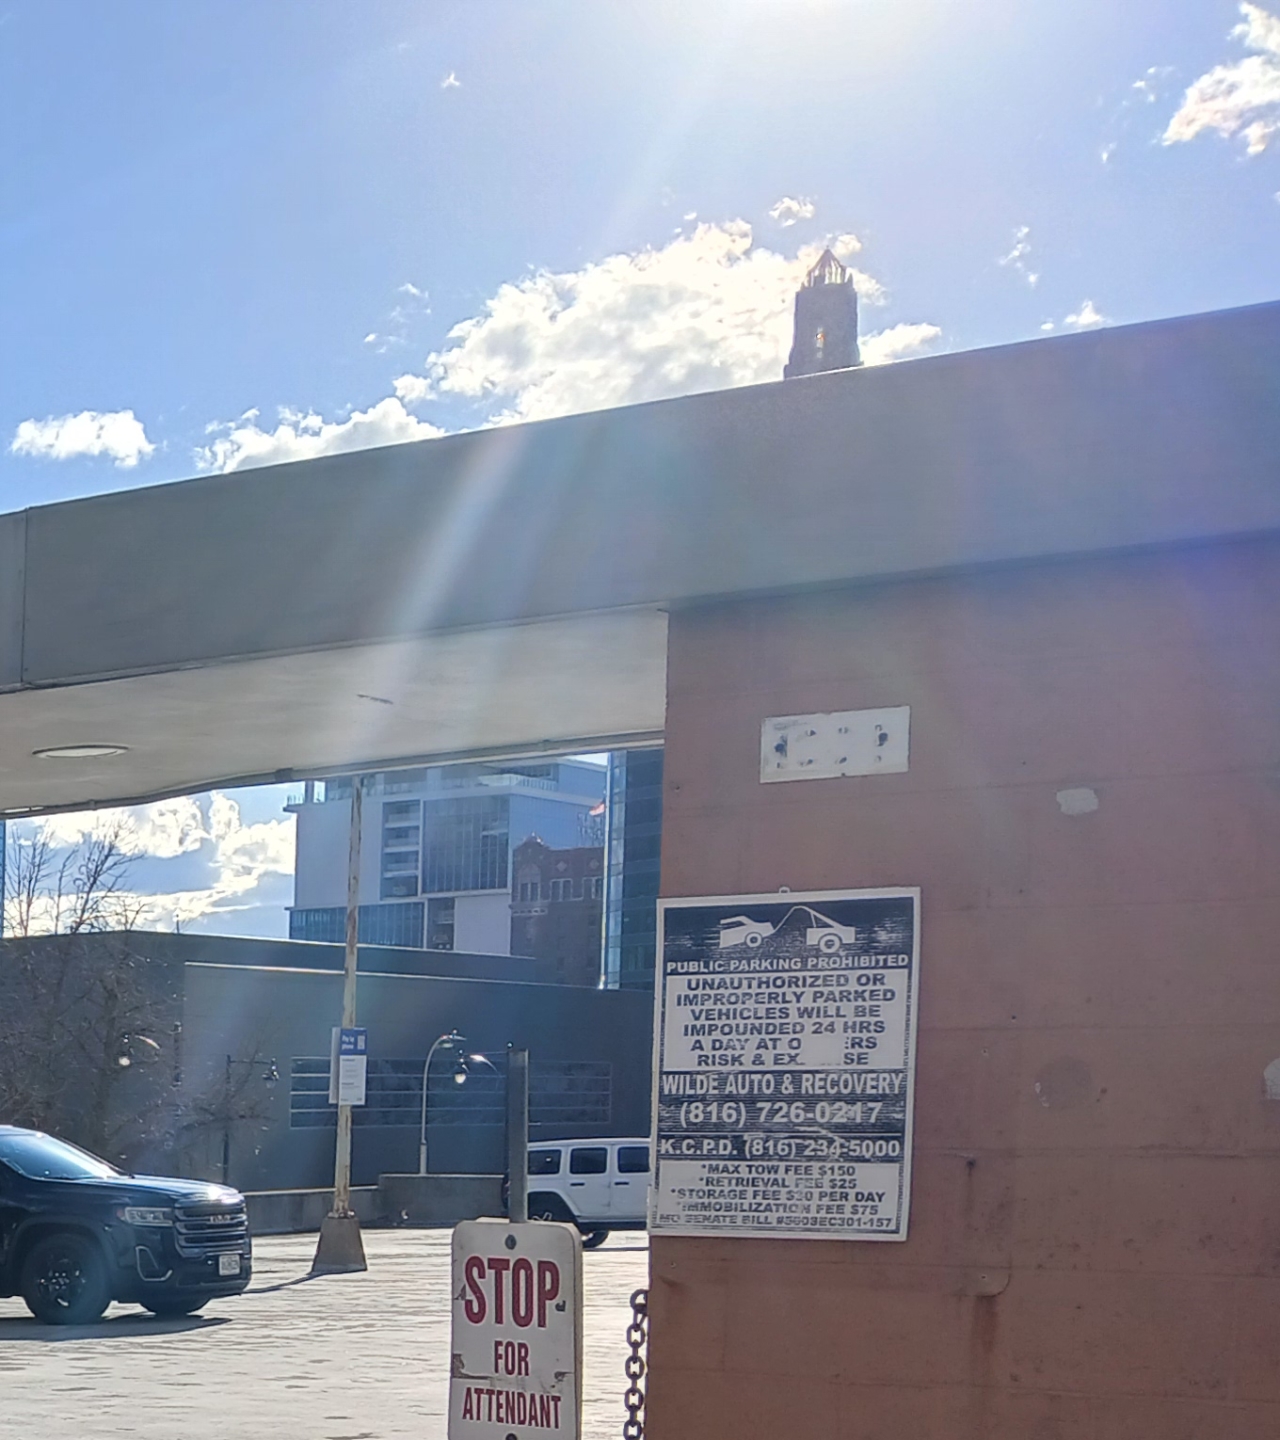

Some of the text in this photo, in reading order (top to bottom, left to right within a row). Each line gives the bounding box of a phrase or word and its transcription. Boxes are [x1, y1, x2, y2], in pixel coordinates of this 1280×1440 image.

[666, 954, 909, 973] PUBLIC PARKING PROHIBITED
[686, 973, 886, 991] UNAUTHORIZED OR
[676, 988, 896, 1006] IMPROPERLY PARKED
[690, 1004, 881, 1021] VEHICLES WILL BE
[683, 1020, 886, 1036] IMPOUNDED 24 HRS
[690, 1039, 705, 1051] A
[711, 1038, 750, 1051] DAY
[755, 1038, 782, 1050] AT
[697, 1053, 745, 1066] RISK
[751, 1053, 766, 1066] &
[662, 1073, 903, 1095] WILDE AUTO & RECOVERY
[680, 1101, 883, 1128] (816) 726-0217
[660, 1138, 900, 1159] K.C.P.D. (816) 234-5000
[746, 1164, 780, 1175] TOW
[784, 1165, 813, 1175] FEE
[818, 1164, 856, 1176] $150
[828, 1178, 857, 1189] $25
[752, 1189, 781, 1200] FEE
[818, 1190, 849, 1202] PER
[854, 1191, 886, 1203] DAY
[816, 1204, 846, 1214] FEE
[850, 1204, 879, 1215] $75
[741, 1214, 773, 1225] BILL
[464, 1255, 561, 1329] STOP
[494, 1340, 530, 1377] FOR
[462, 1386, 562, 1430] ATTENDANT
